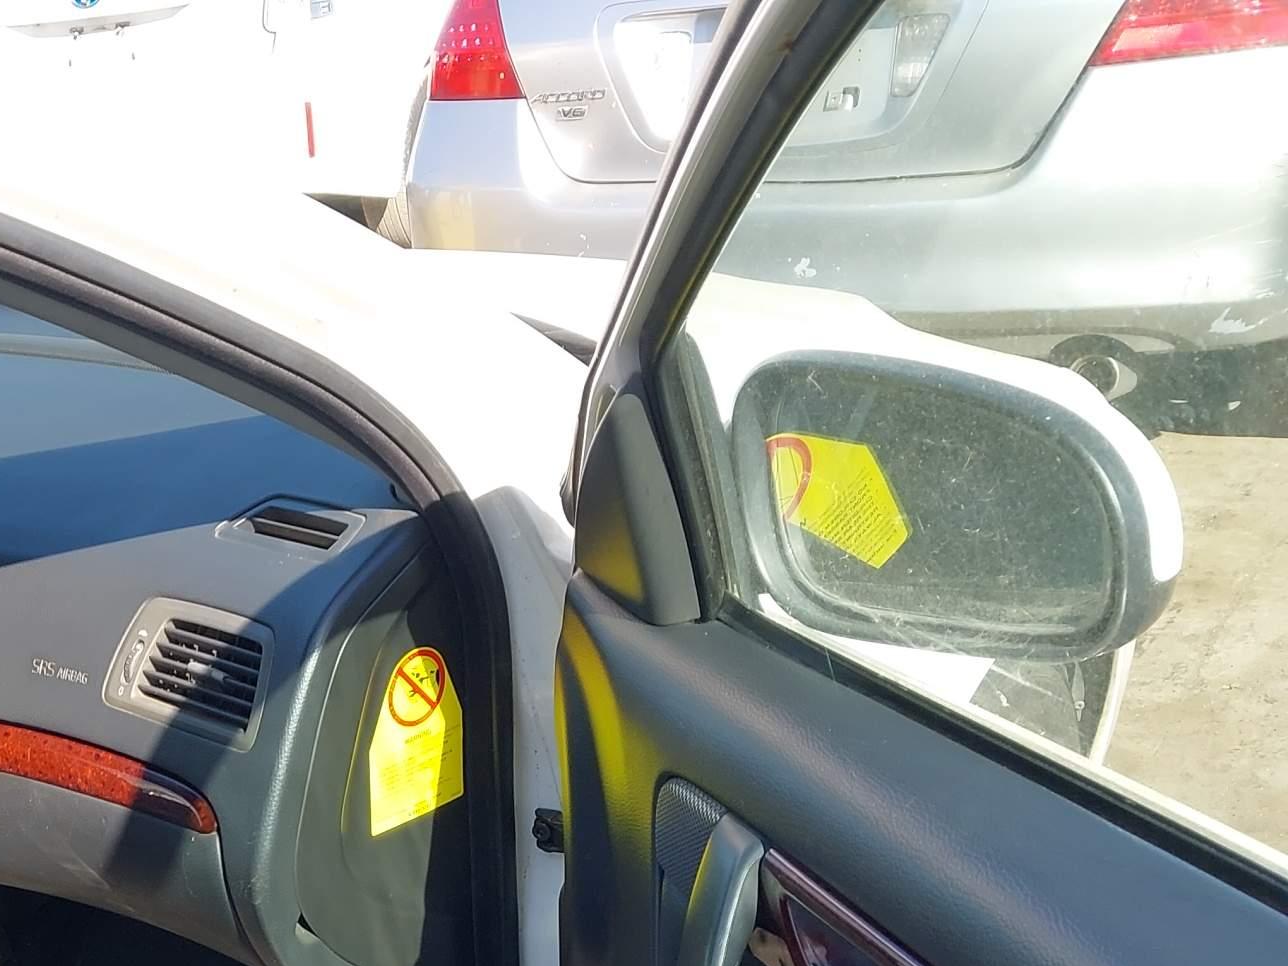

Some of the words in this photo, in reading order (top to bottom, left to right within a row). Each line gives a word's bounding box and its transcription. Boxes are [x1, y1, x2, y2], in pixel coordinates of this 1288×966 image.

[531, 88, 606, 104] ACCORD
[558, 107, 587, 119] V6
[32, 658, 56, 677] SRS
[56, 667, 88, 685] AIRBAG
